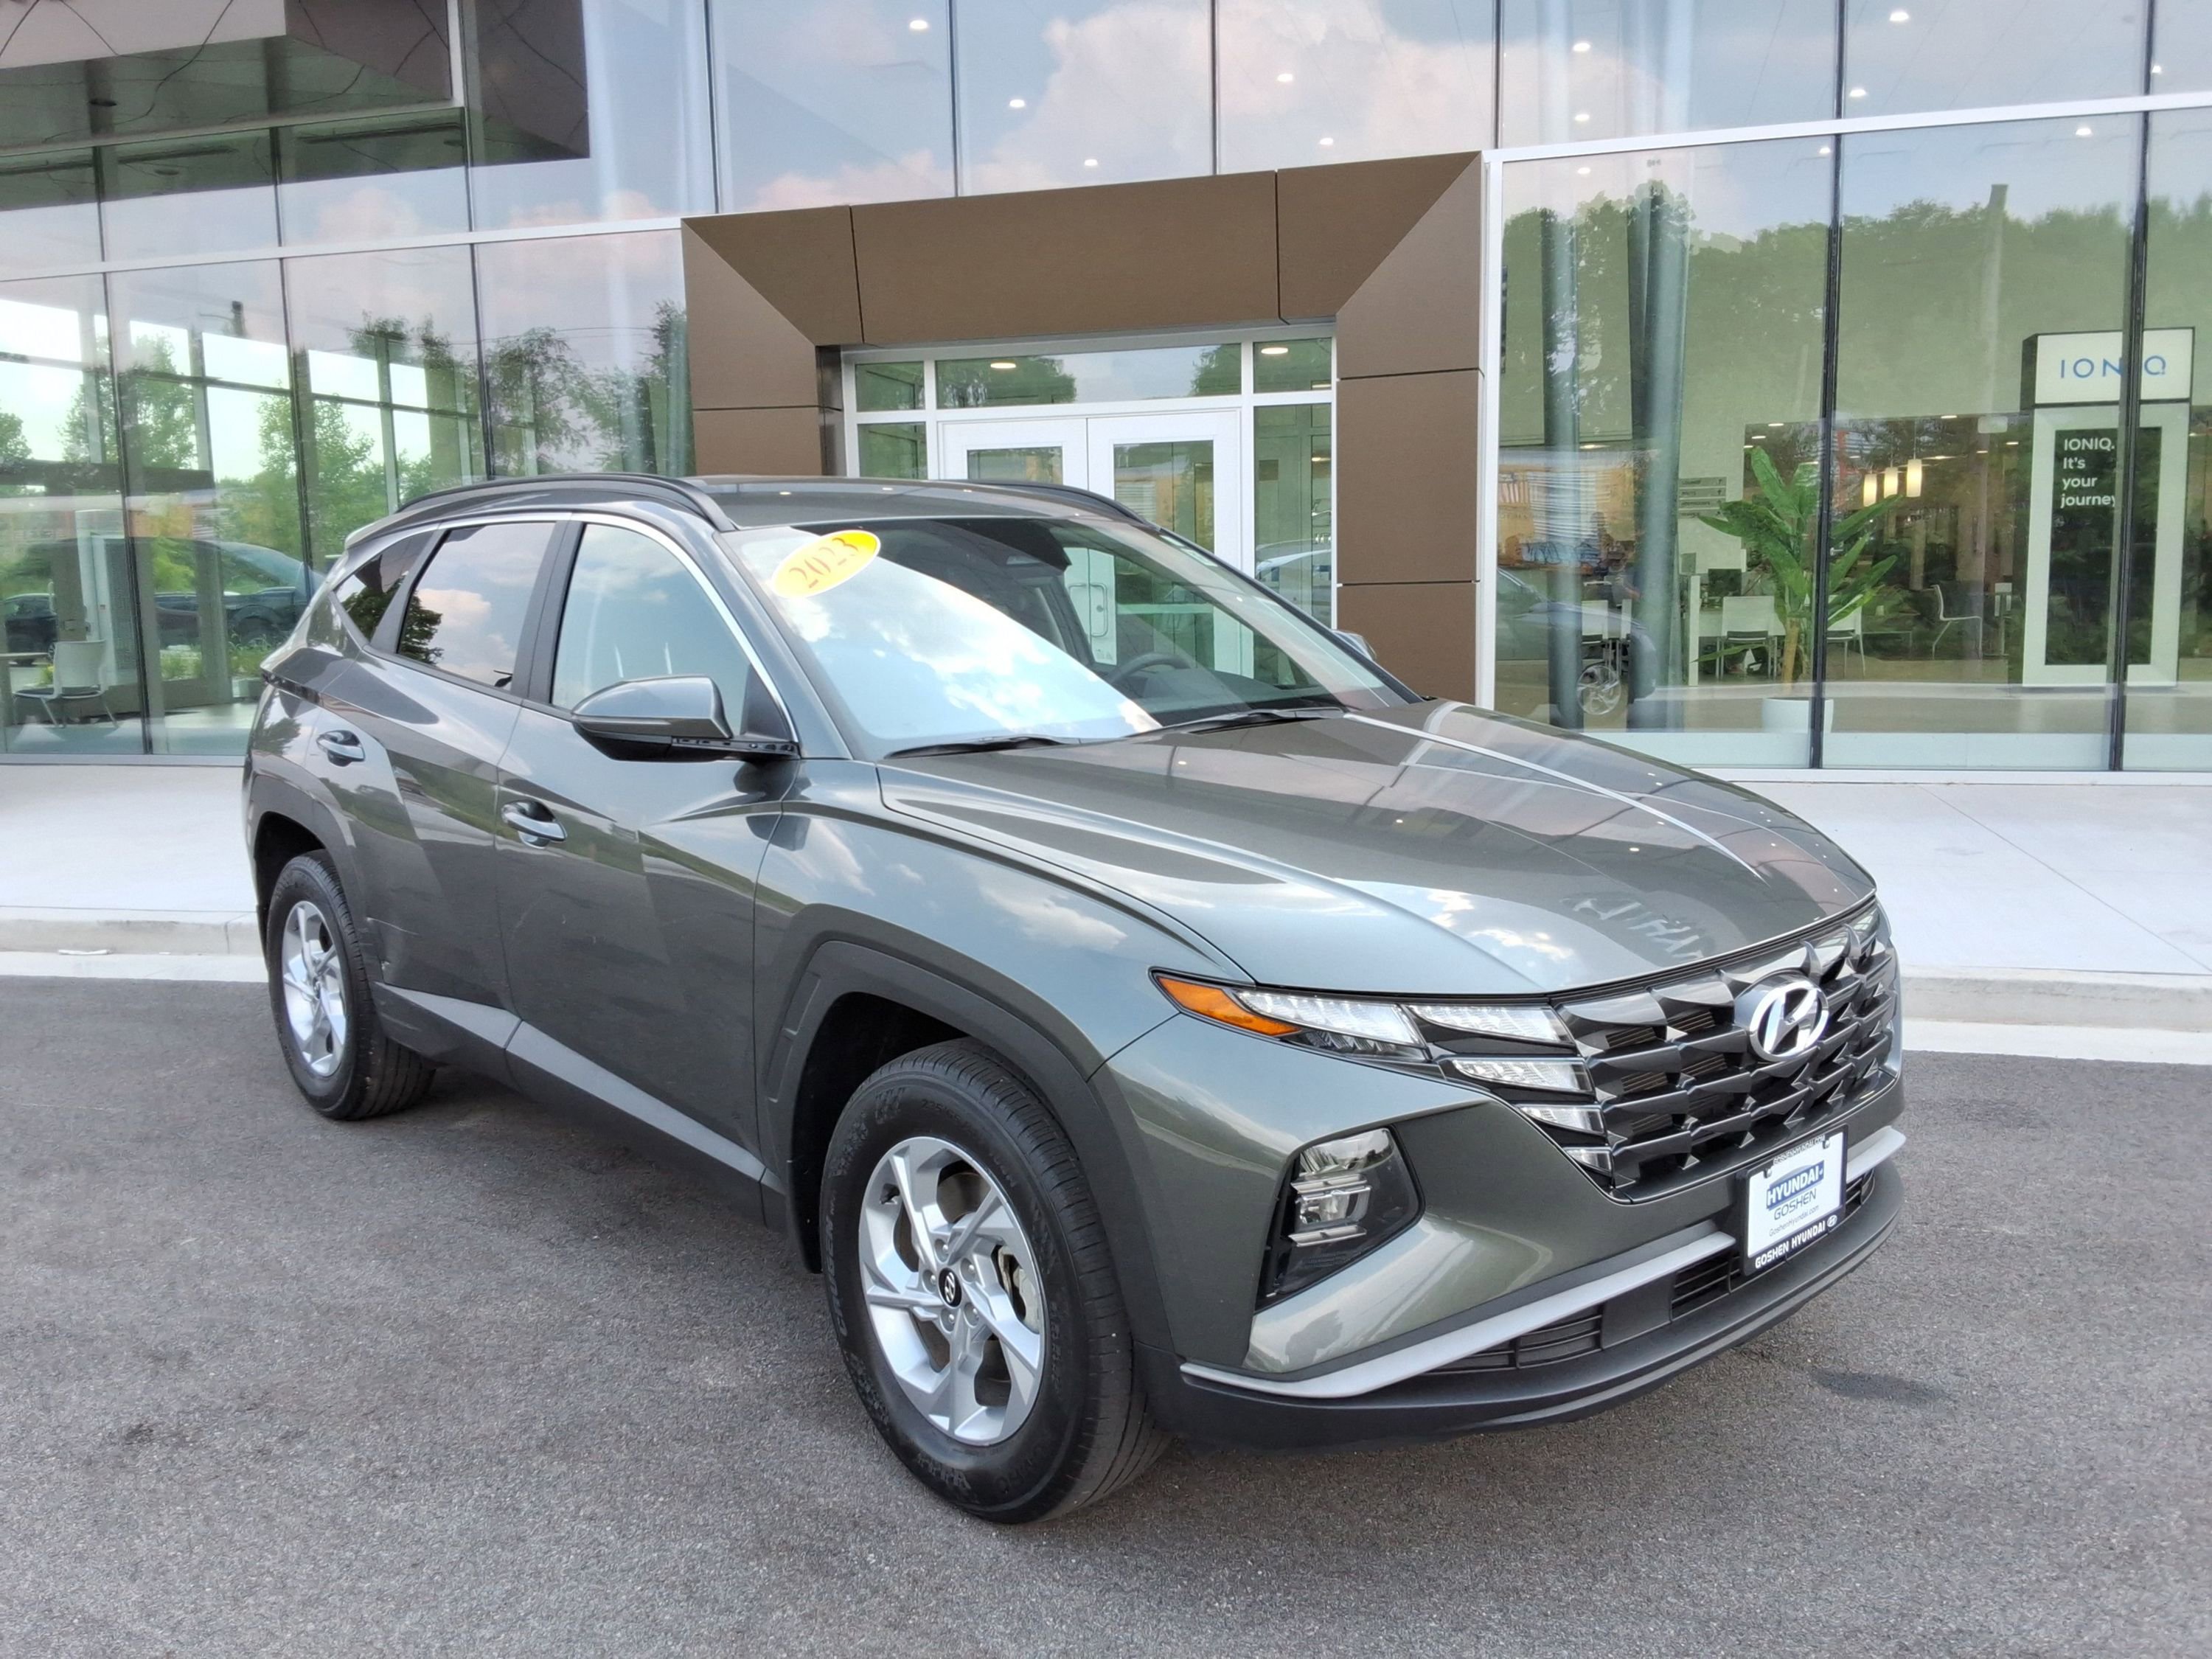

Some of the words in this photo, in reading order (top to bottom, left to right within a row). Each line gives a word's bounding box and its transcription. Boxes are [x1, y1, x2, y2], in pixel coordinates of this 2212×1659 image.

[2060, 355, 2166, 379] IONQ
[2064, 437, 2115, 452] IONIQ.
[2063, 457, 2086, 470] It's
[2062, 476, 2098, 490] your
[789, 537, 860, 588] 2023
[1767, 1165, 1820, 1207] HYUNDAI
[1774, 1188, 1817, 1220] GOSHEN
[1755, 1240, 1790, 1270] GOSHEN
[1791, 1220, 1826, 1249] HYUNDAI
